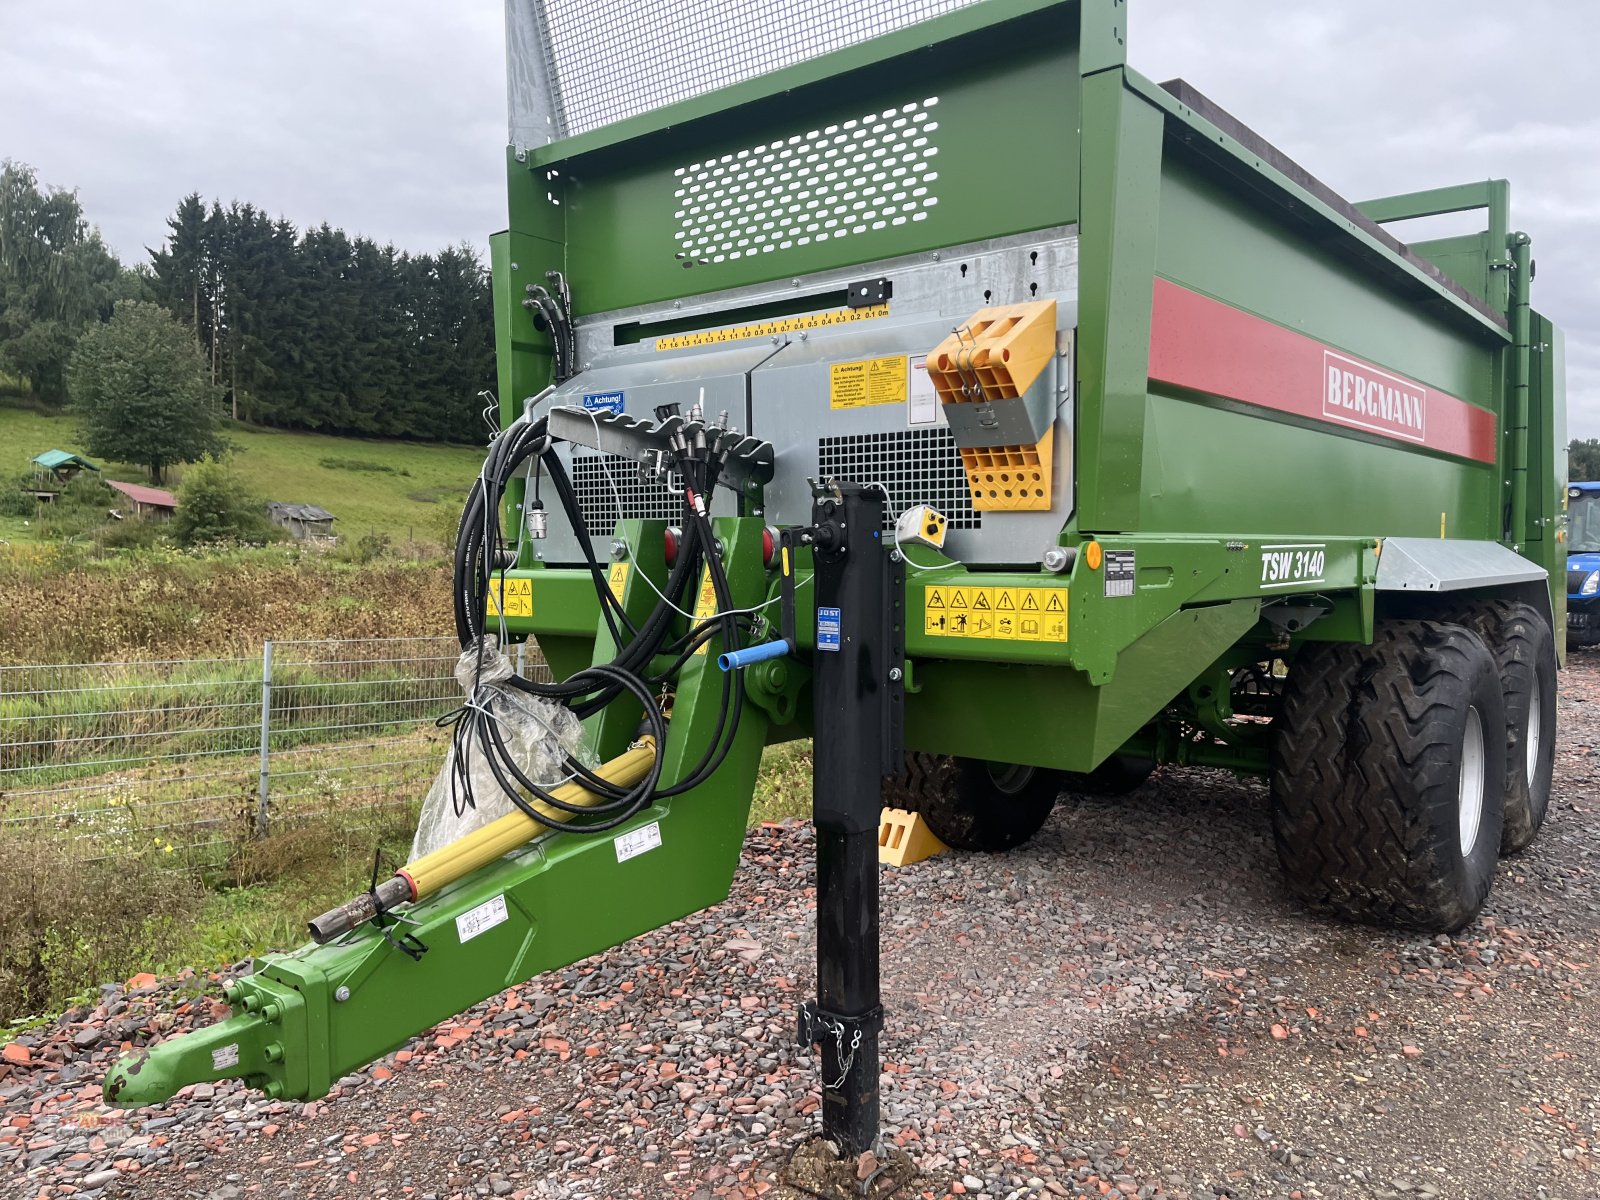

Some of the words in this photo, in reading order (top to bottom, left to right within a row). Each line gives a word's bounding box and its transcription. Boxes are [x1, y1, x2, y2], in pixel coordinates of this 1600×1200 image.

[594, 394, 621, 404] Achtung!
[1328, 365, 1422, 430] BERGMANN
[1262, 552, 1294, 581] TSW
[1294, 550, 1324, 578] 3140
